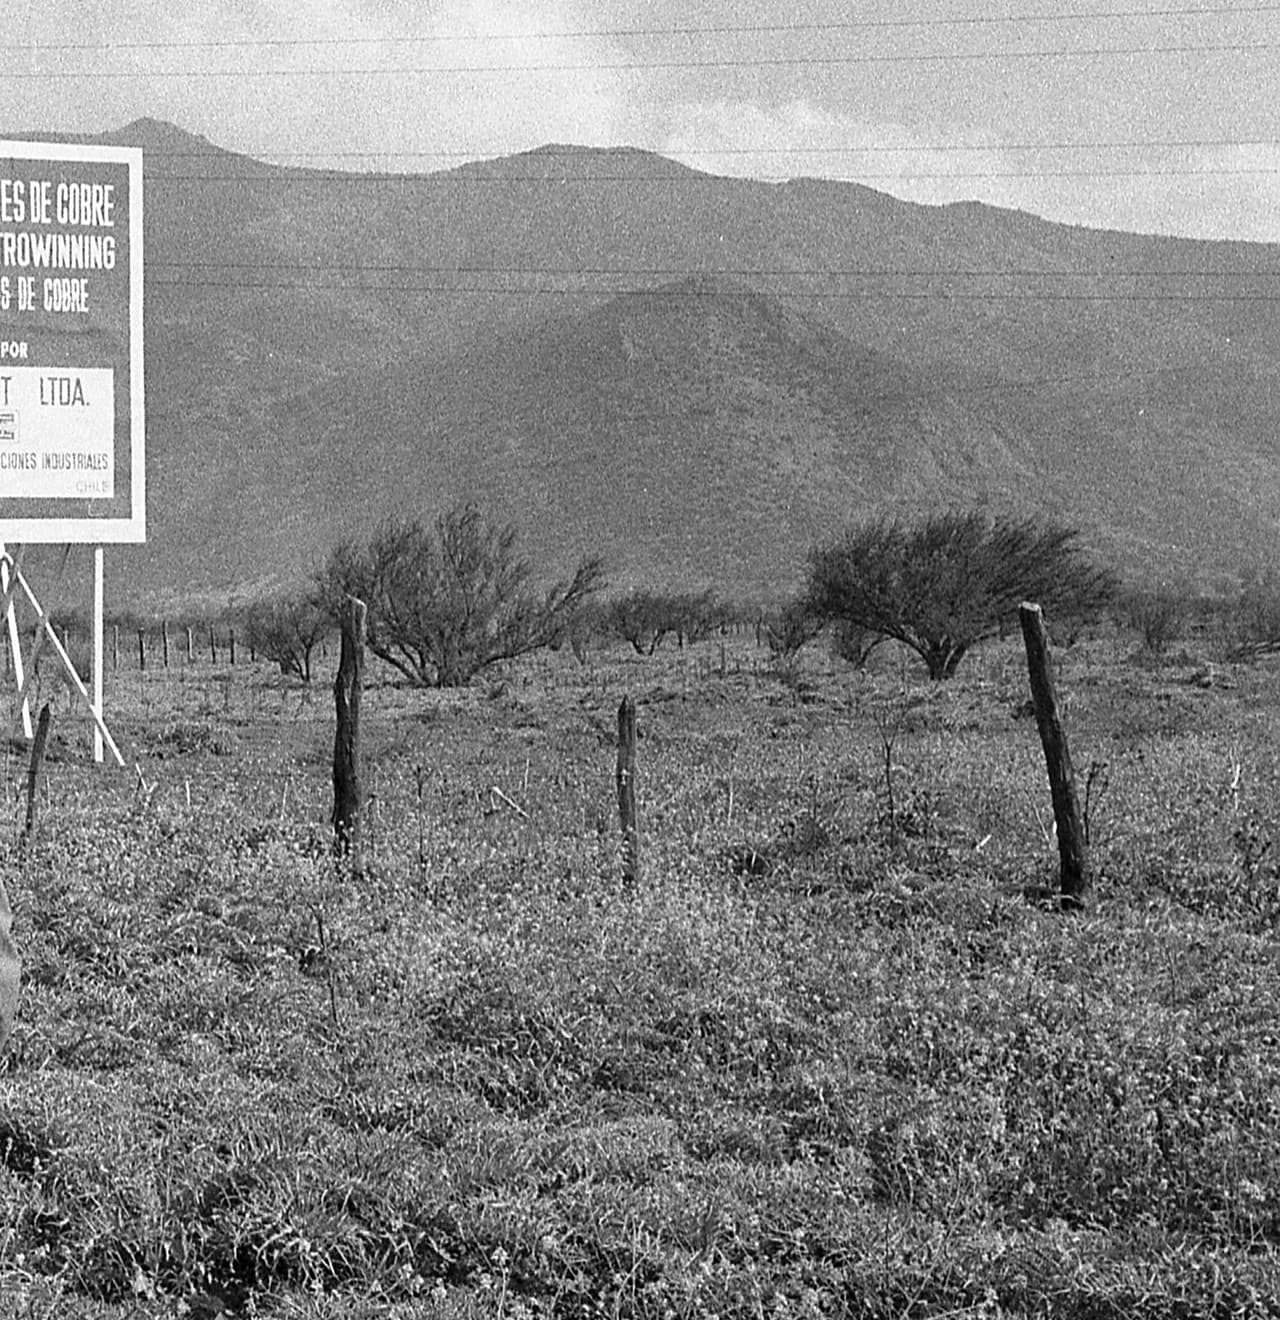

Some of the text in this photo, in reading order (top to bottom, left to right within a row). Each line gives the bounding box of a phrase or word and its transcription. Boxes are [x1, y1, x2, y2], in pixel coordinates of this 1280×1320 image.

[30, 181, 52, 224] DE
[56, 183, 115, 227] COBRE
[18, 276, 36, 311] DE
[43, 278, 90, 313] COBRE
[0, 341, 28, 359] POR
[40, 376, 91, 407] LTDA.
[42, 453, 109, 470] INDUSTRIALES
